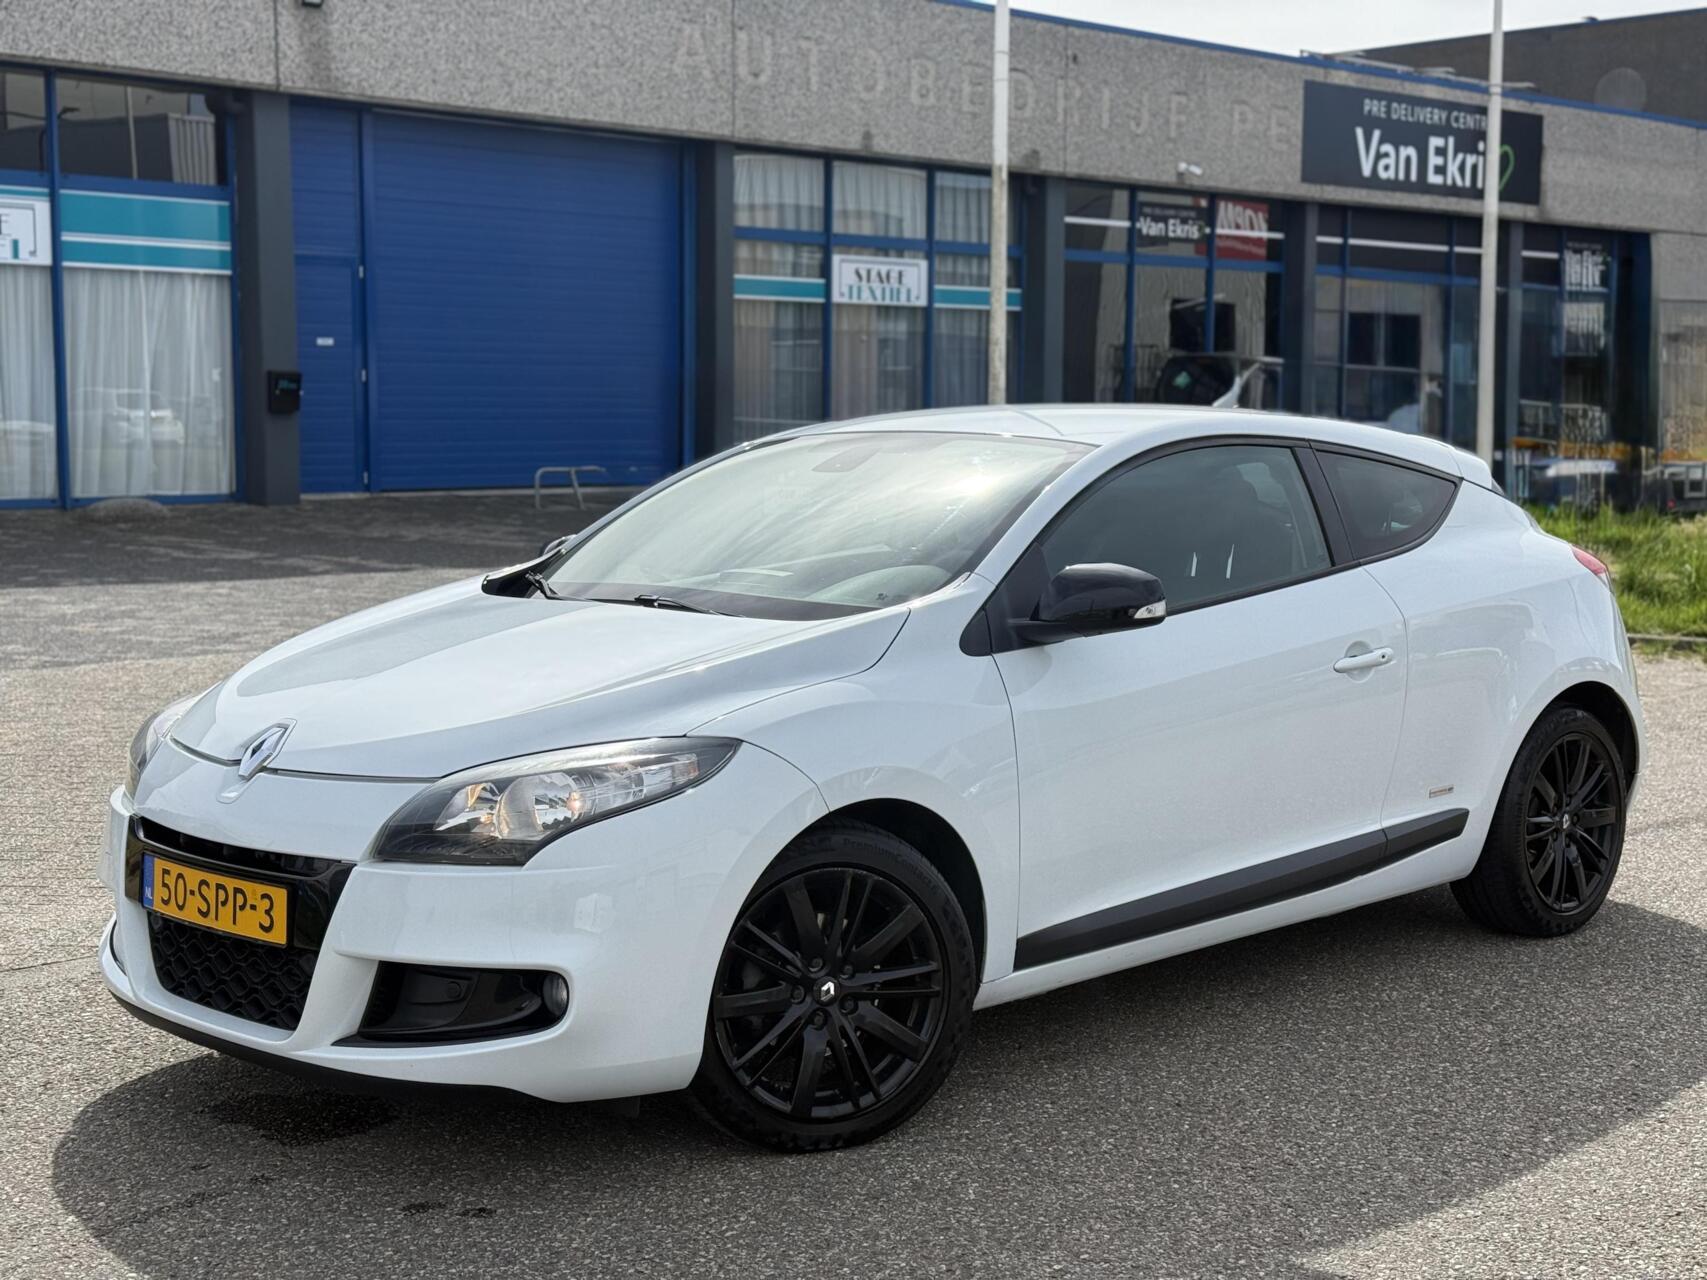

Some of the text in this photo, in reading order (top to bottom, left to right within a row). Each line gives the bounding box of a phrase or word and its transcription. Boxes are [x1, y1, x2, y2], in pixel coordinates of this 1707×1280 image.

[1363, 98, 1488, 131] PRE DELIVERY CENTR
[1355, 126, 1486, 190] Van Ekri
[1140, 216, 1166, 237] Van
[1168, 218, 1200, 239] Ekris
[854, 267, 904, 285] STAGE
[144, 886, 153, 900] NL
[160, 867, 275, 934] 50-SPP-3
